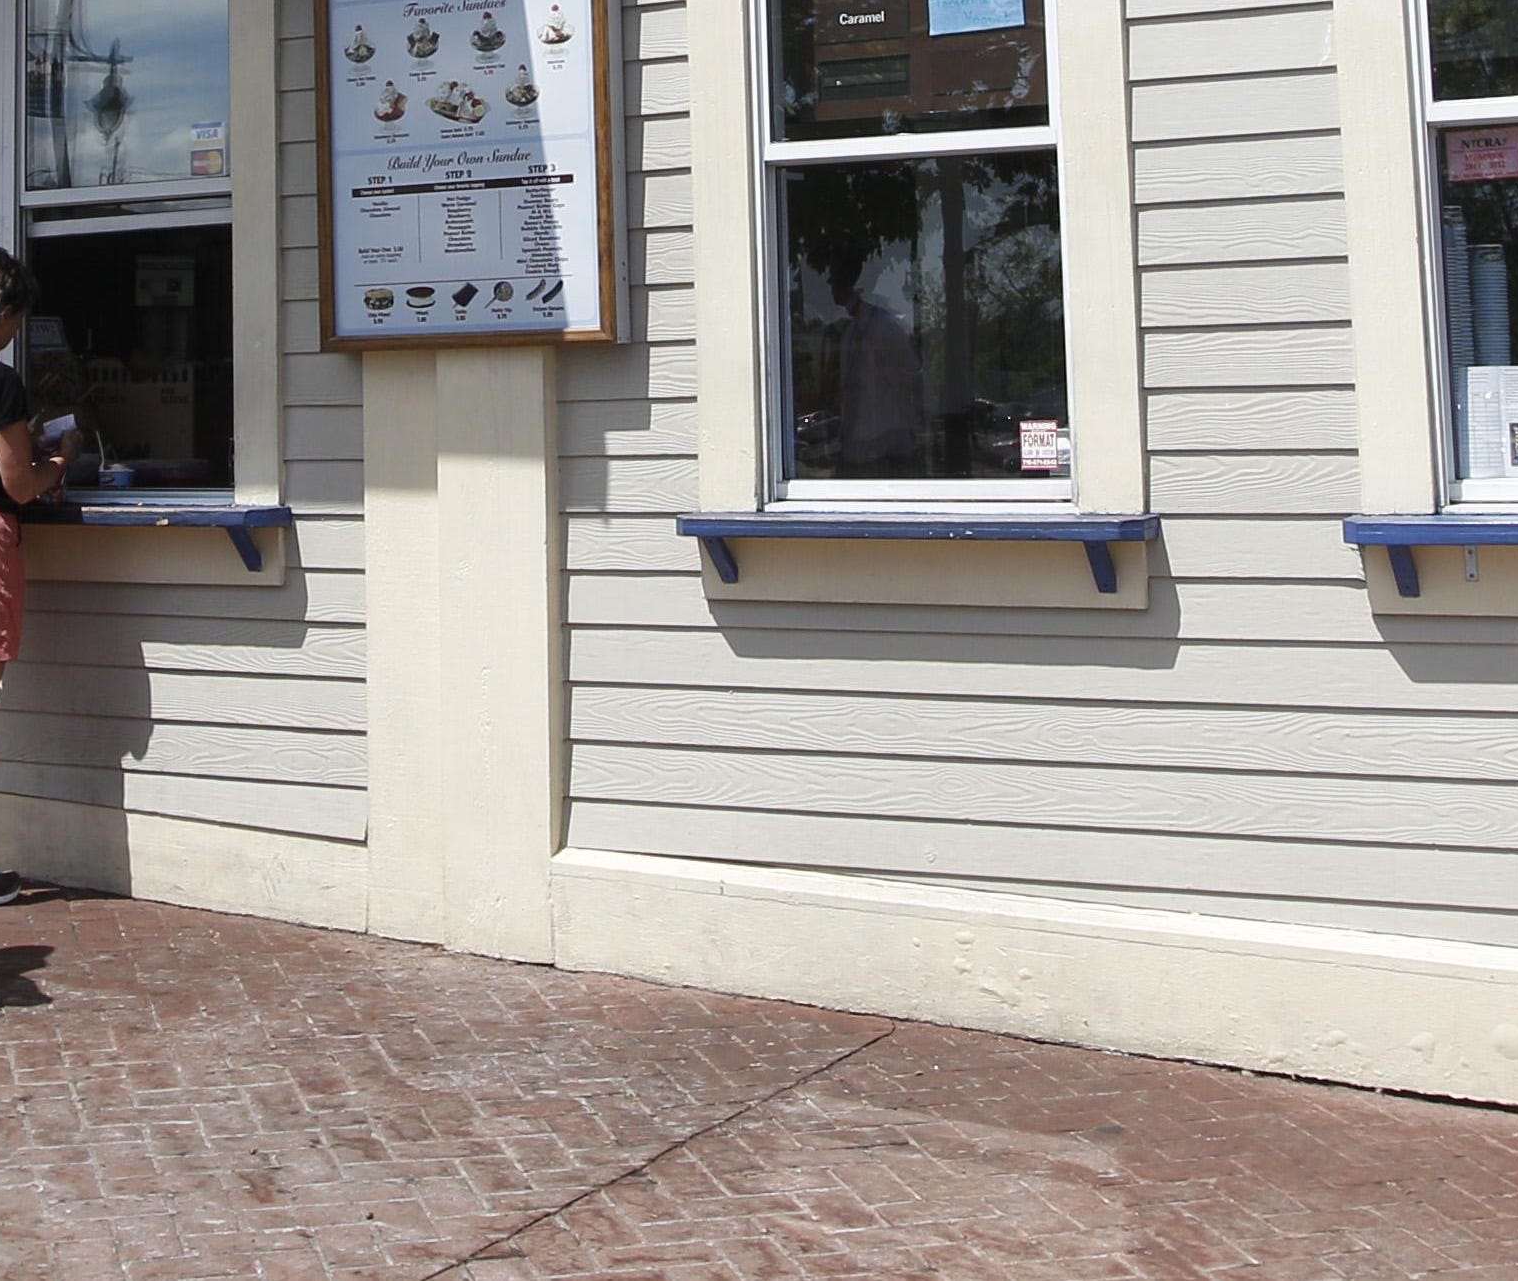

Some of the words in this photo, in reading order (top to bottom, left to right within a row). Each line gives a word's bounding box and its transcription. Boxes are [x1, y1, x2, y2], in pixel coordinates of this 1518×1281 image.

[403, 2, 454, 18] Favorite
[839, 10, 885, 26] Caramel
[196, 129, 219, 139] VISA
[387, 153, 420, 170] Build
[423, 152, 454, 172] Your
[457, 150, 483, 165] Own
[487, 147, 531, 163] Sundae
[445, 170, 464, 179] STEP
[466, 170, 472, 178] 2
[528, 164, 547, 174] STEP
[367, 176, 386, 184] STEP
[1023, 433, 1055, 447] FORMAT
